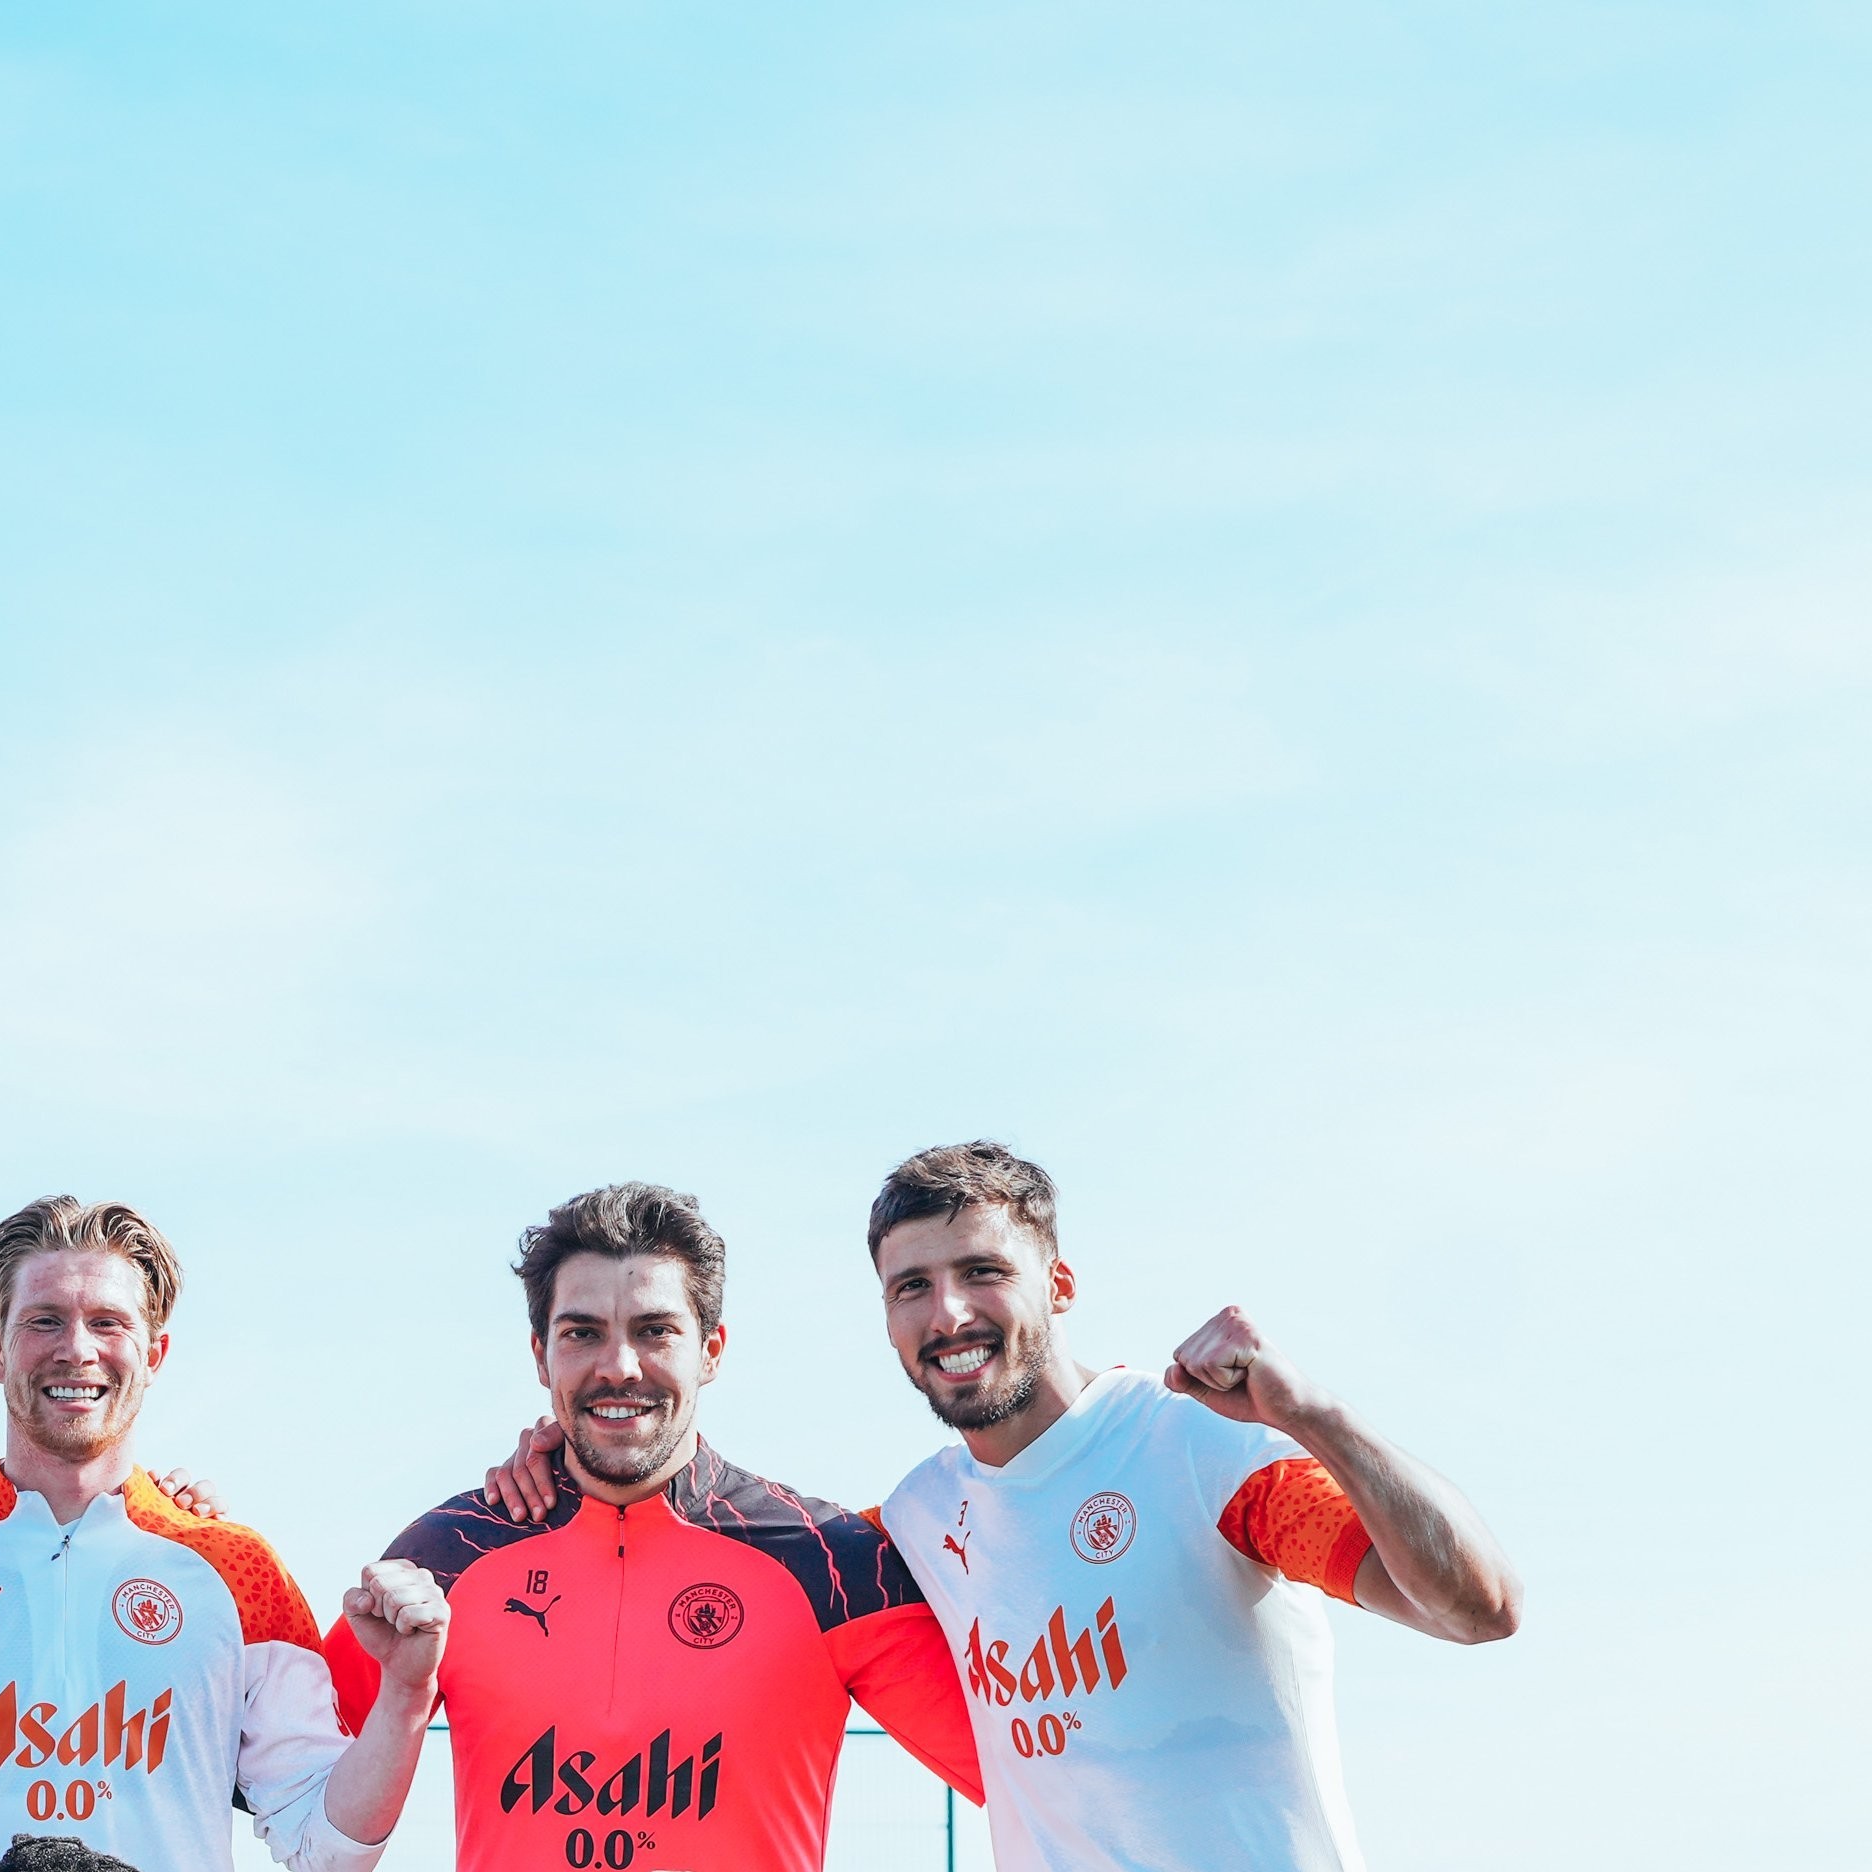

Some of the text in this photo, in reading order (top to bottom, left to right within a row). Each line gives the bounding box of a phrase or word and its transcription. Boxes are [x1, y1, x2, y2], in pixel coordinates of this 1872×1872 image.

[1077, 1496, 1129, 1525] MANCHESTER
[1094, 1549, 1115, 1560] CITY
[121, 1582, 176, 1611] MANCHESTER
[525, 1568, 549, 1596] 18
[678, 1588, 737, 1611] MANCHESTER
[136, 1630, 157, 1640] CITY
[692, 1636, 716, 1646] CITY
[965, 1595, 1128, 1707] Asahi
[1011, 1710, 1083, 1760] 0.0%
[500, 1725, 723, 1821] Asahi
[26, 1779, 114, 1822] 0.0%
[565, 1828, 656, 1871] 0.0%
